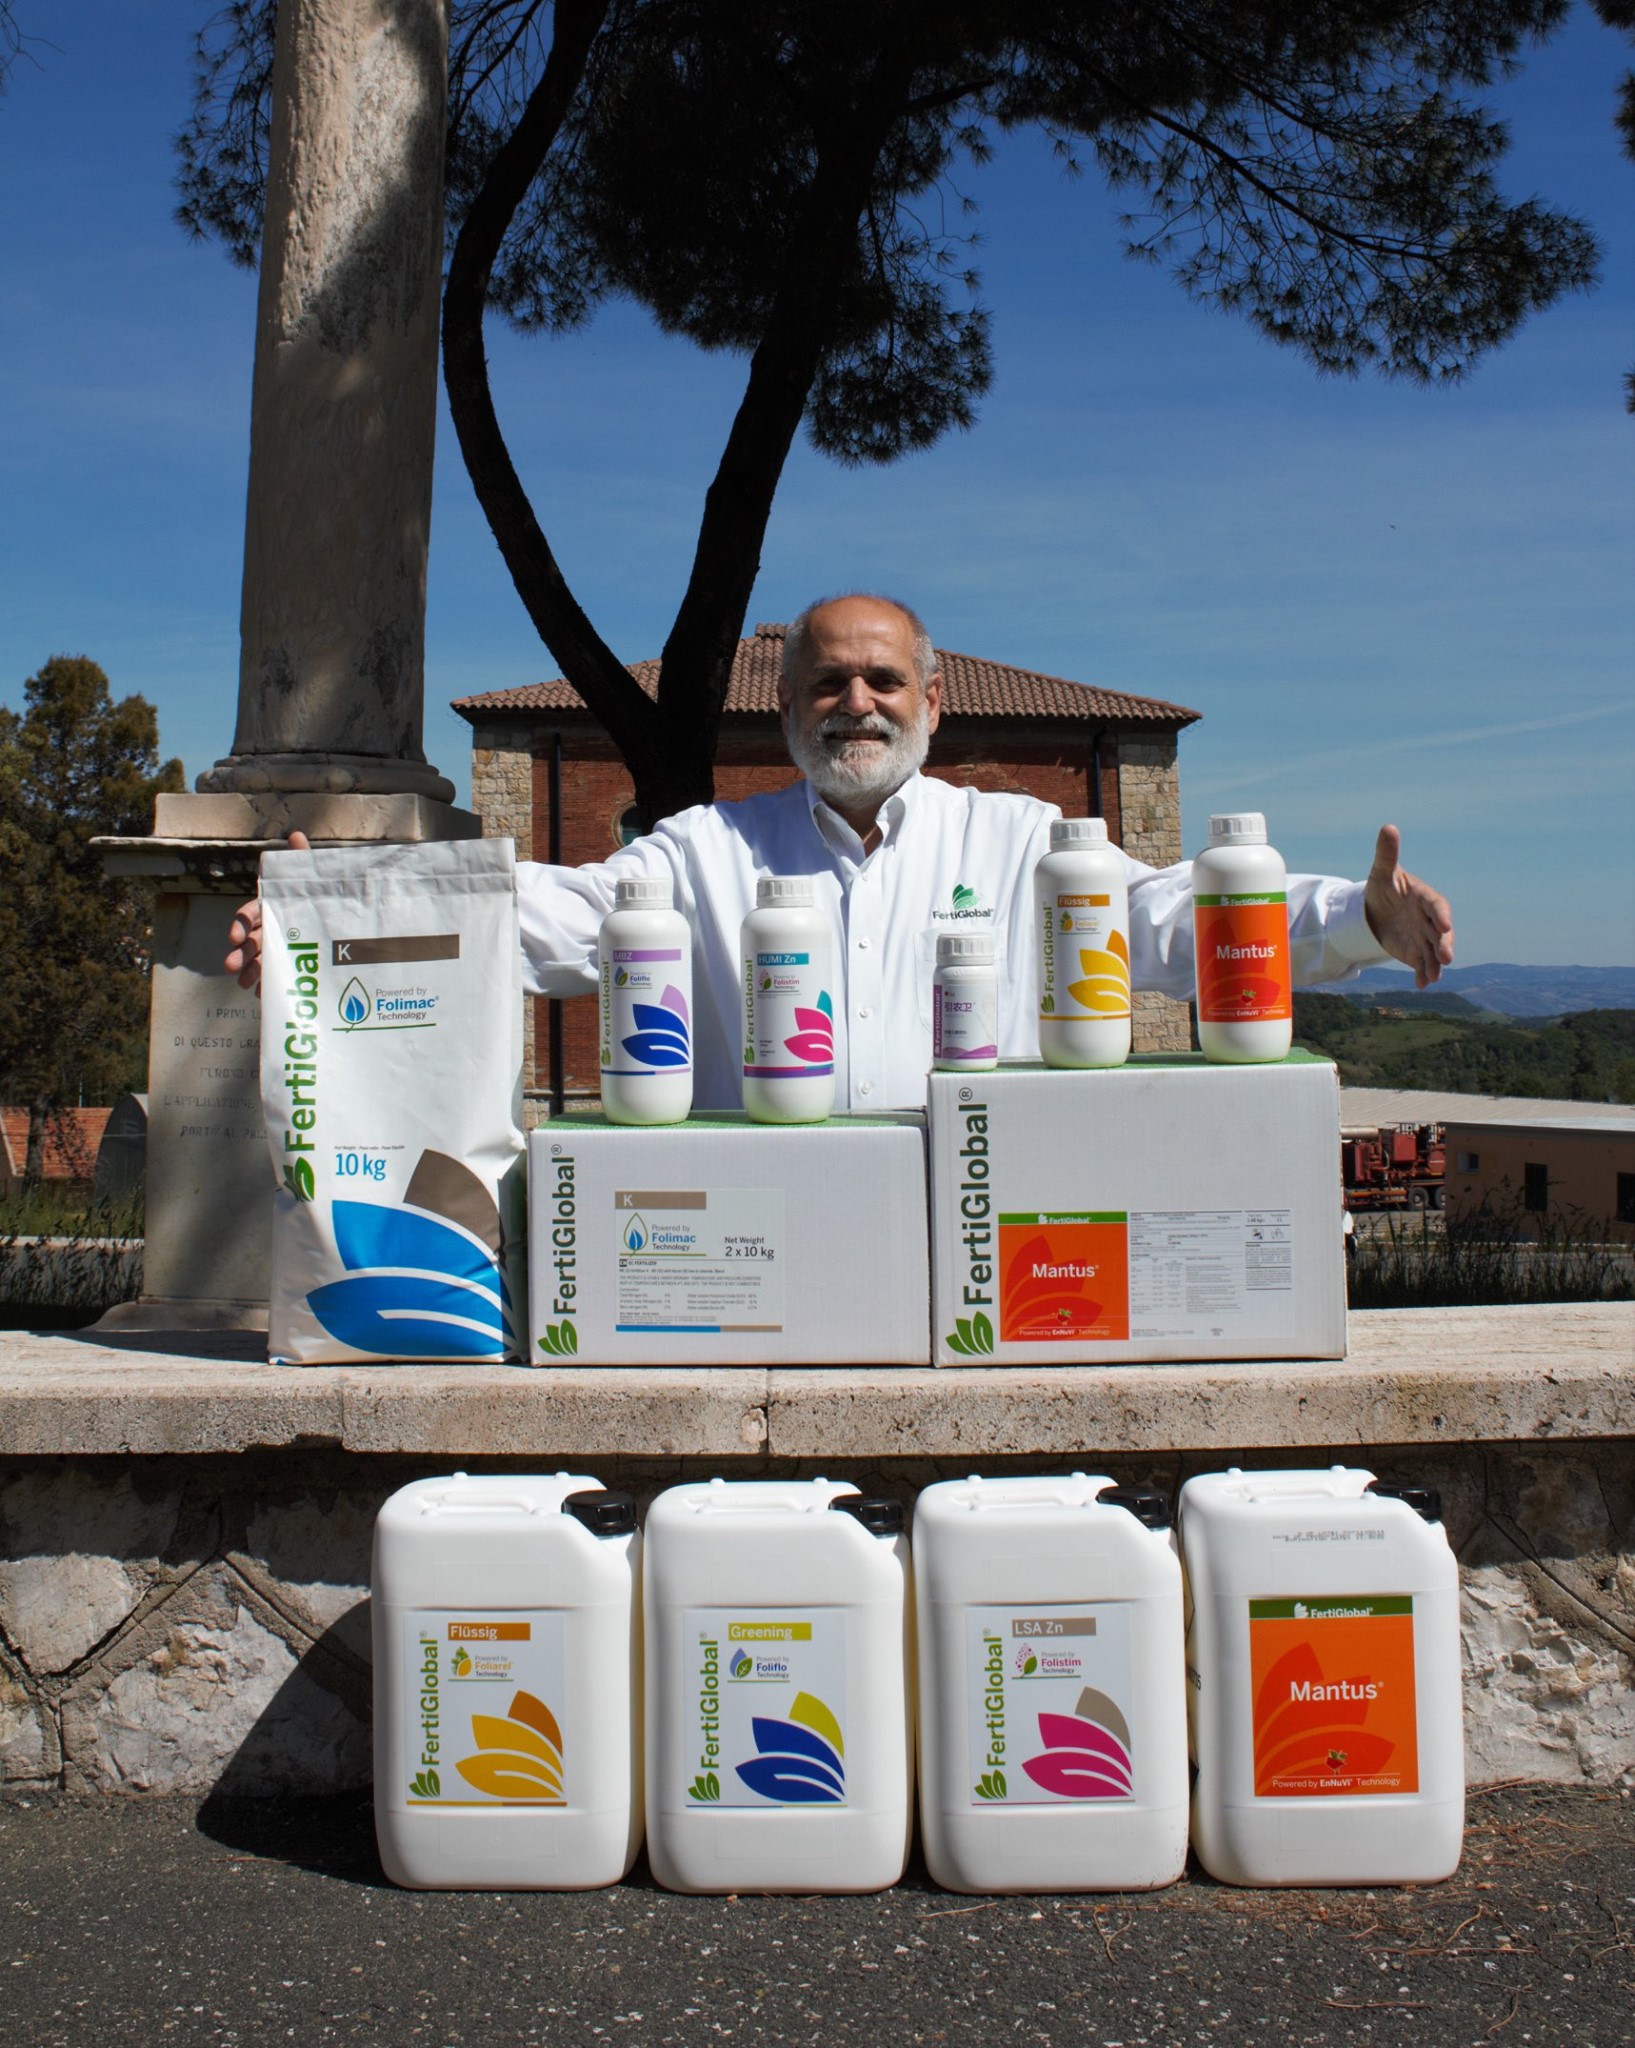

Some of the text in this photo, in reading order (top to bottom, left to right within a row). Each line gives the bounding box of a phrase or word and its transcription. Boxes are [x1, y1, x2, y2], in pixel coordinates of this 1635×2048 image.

[1059, 897, 1091, 906] Flüssig
[933, 908, 992, 920] FertiGlobal
[338, 943, 352, 961] K
[1043, 907, 1054, 991] FertiGlobal
[1216, 945, 1276, 959] Mantus
[614, 952, 633, 960] MBZ
[758, 955, 796, 965] HUMI Zn
[376, 987, 428, 997] Powered by
[602, 961, 611, 1045] FertiGlobal
[745, 959, 755, 1043] FertiGlobal
[377, 1011, 427, 1021] Technology
[191, 1037, 233, 1048] QUESTO
[335, 1153, 387, 1181] 10 kg
[623, 1195, 633, 1206] K
[652, 1224, 690, 1233] Powered by
[652, 1233, 696, 1243] Folimac
[724, 1236, 765, 1246] Net Weight
[652, 1243, 690, 1252] Technology
[725, 1246, 774, 1259] 2 x 10 kg
[1032, 1264, 1095, 1278] Mantus
[1044, 1329, 1051, 1337] by
[1310, 1608, 1371, 1618] FertiGlobal
[450, 1625, 498, 1640] Flüssig
[730, 1626, 793, 1640] Greening
[1015, 1621, 1063, 1635] LSA Zn
[500, 1655, 508, 1663] by
[1067, 1651, 1075, 1659] by
[475, 1661, 512, 1670] Foliarel
[756, 1662, 787, 1672] Foliflo
[1041, 1658, 1081, 1667] Folistim
[475, 1670, 508, 1678] Technology
[757, 1671, 789, 1679] Technology
[1290, 1681, 1378, 1702] Mantus
[1272, 1779, 1307, 1788] Powered
[1308, 1779, 1317, 1788] by
[1357, 1777, 1401, 1786] Technology
